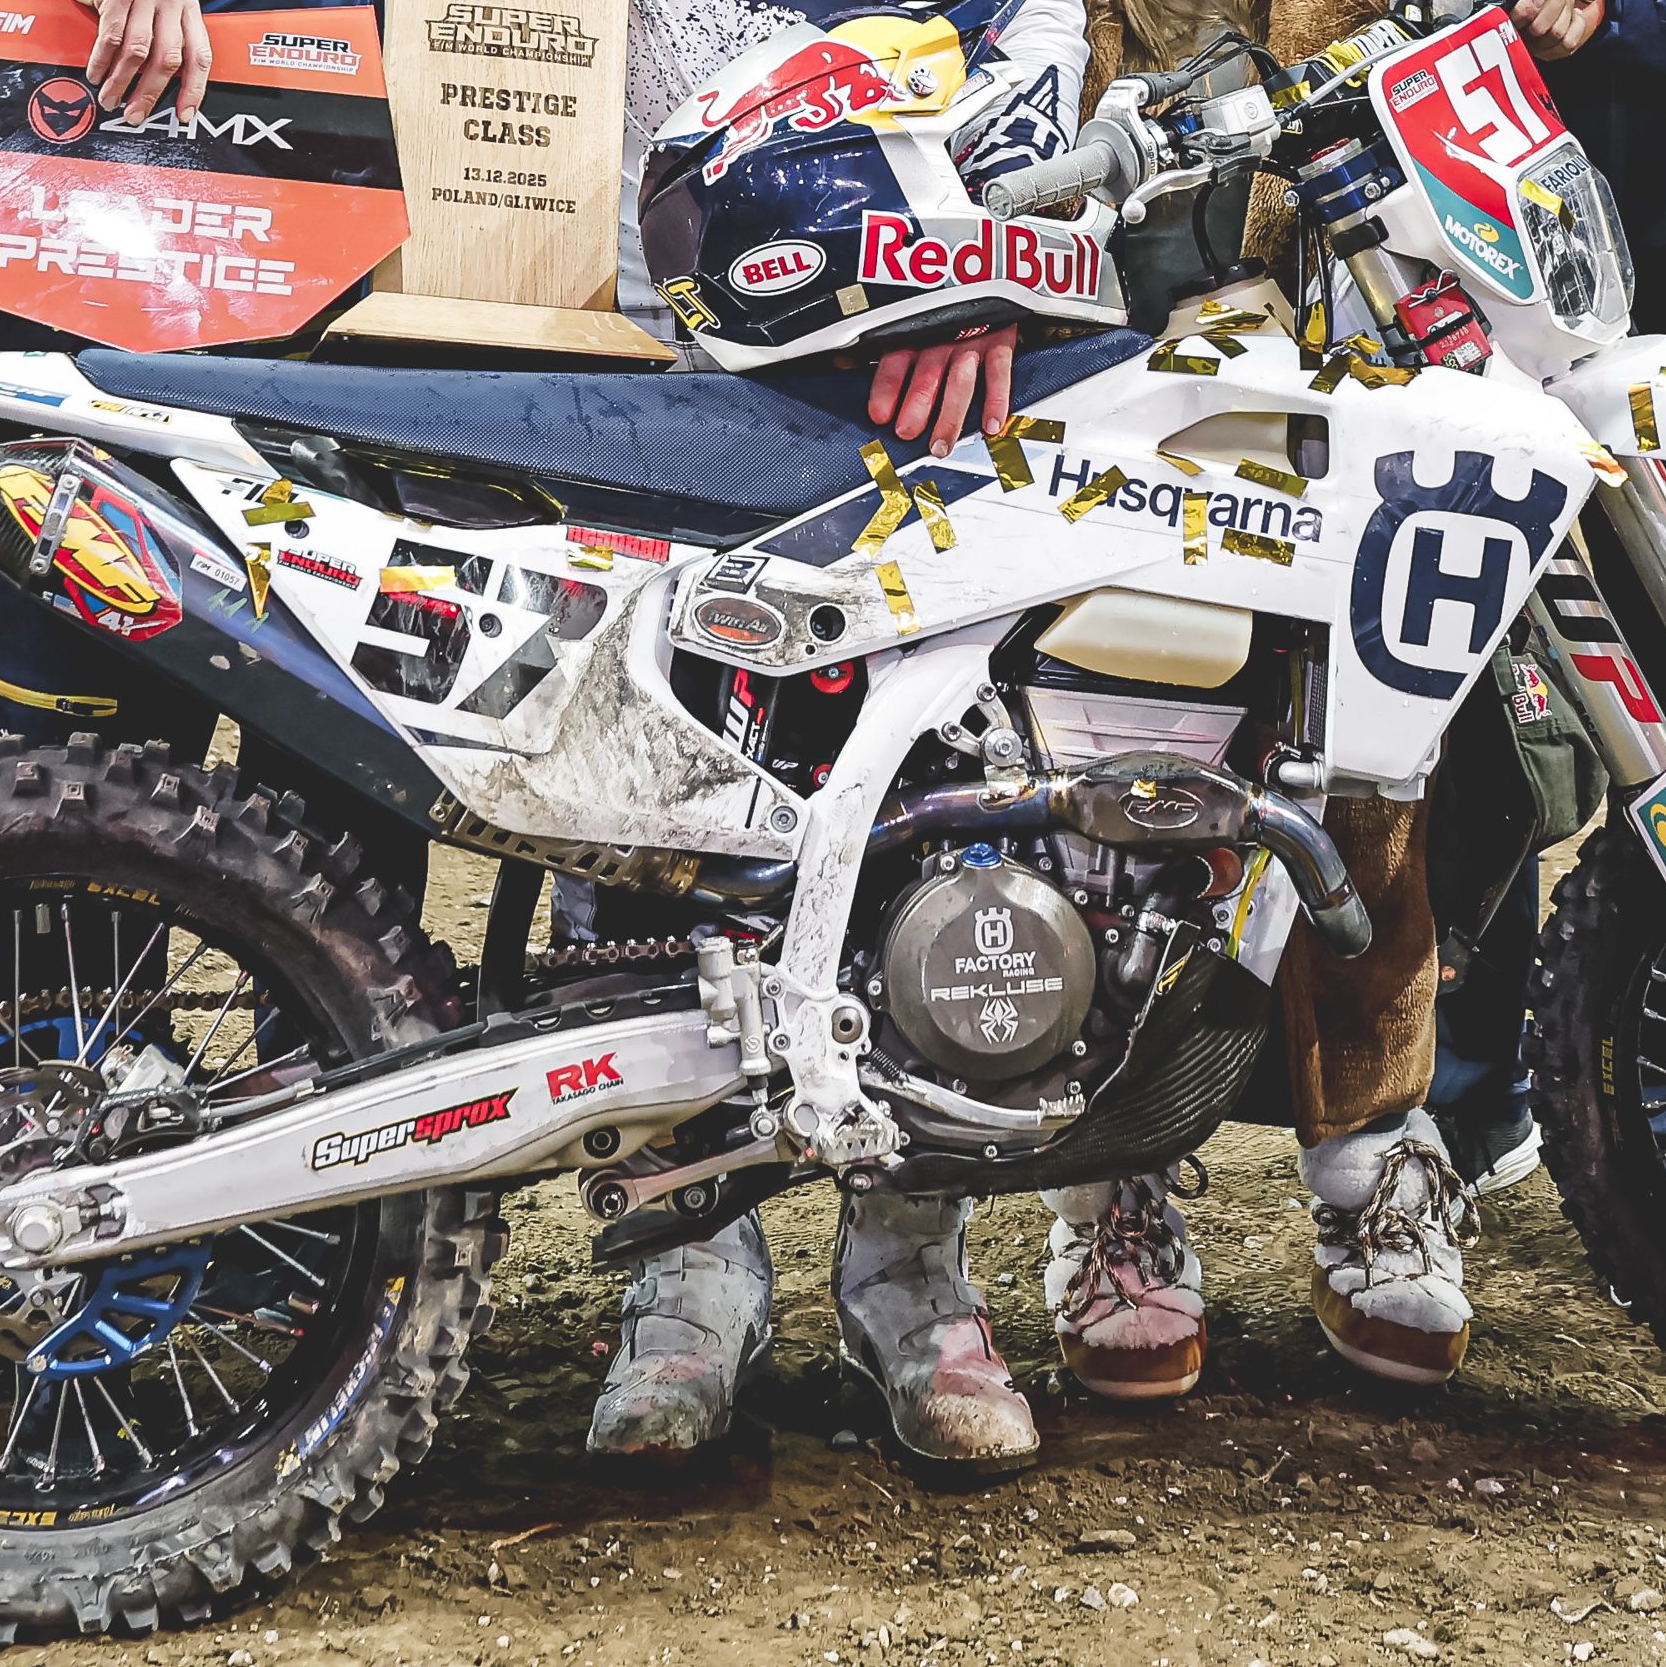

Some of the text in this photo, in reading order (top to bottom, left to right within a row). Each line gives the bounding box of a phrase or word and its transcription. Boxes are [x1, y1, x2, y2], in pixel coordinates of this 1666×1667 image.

[447, 5, 581, 35] SUPER
[263, 34, 349, 53] SUPER
[429, 22, 594, 54] ENDURO
[252, 45, 357, 66] ENDURO
[297, 61, 354, 73] CHAMPIONSHIP
[434, 41, 589, 65] FIM WORLD CHAMPIONSHIP
[1392, 70, 1428, 96] SUPER
[1392, 77, 1436, 107] ENDURO
[1435, 28, 1551, 167] 57
[440, 82, 577, 118] PRESTIGE
[463, 119, 552, 148] CLASS
[463, 167, 547, 187] 13.12.2025
[1540, 155, 1590, 194] FARIOLI
[431, 187, 576, 214] POLAND/GLIWICE
[864, 213, 1101, 299] Red Bull
[1444, 214, 1520, 280] MOTOREX
[742, 252, 813, 286] BELL
[1049, 454, 1323, 543] Hsqarna
[288, 549, 357, 575] SUPER
[291, 563, 312, 575] WORLD
[214, 569, 241, 586] 01057
[1513, 693, 1535, 723] Bull
[954, 950, 1037, 974] FACTORY
[1002, 967, 1035, 978] RACING
[930, 977, 1064, 1002] REKLUSE
[546, 1051, 621, 1098] RK
[552, 1077, 625, 1106] TAKASAGO CHAIN
[314, 1092, 511, 1170] Supersprox
